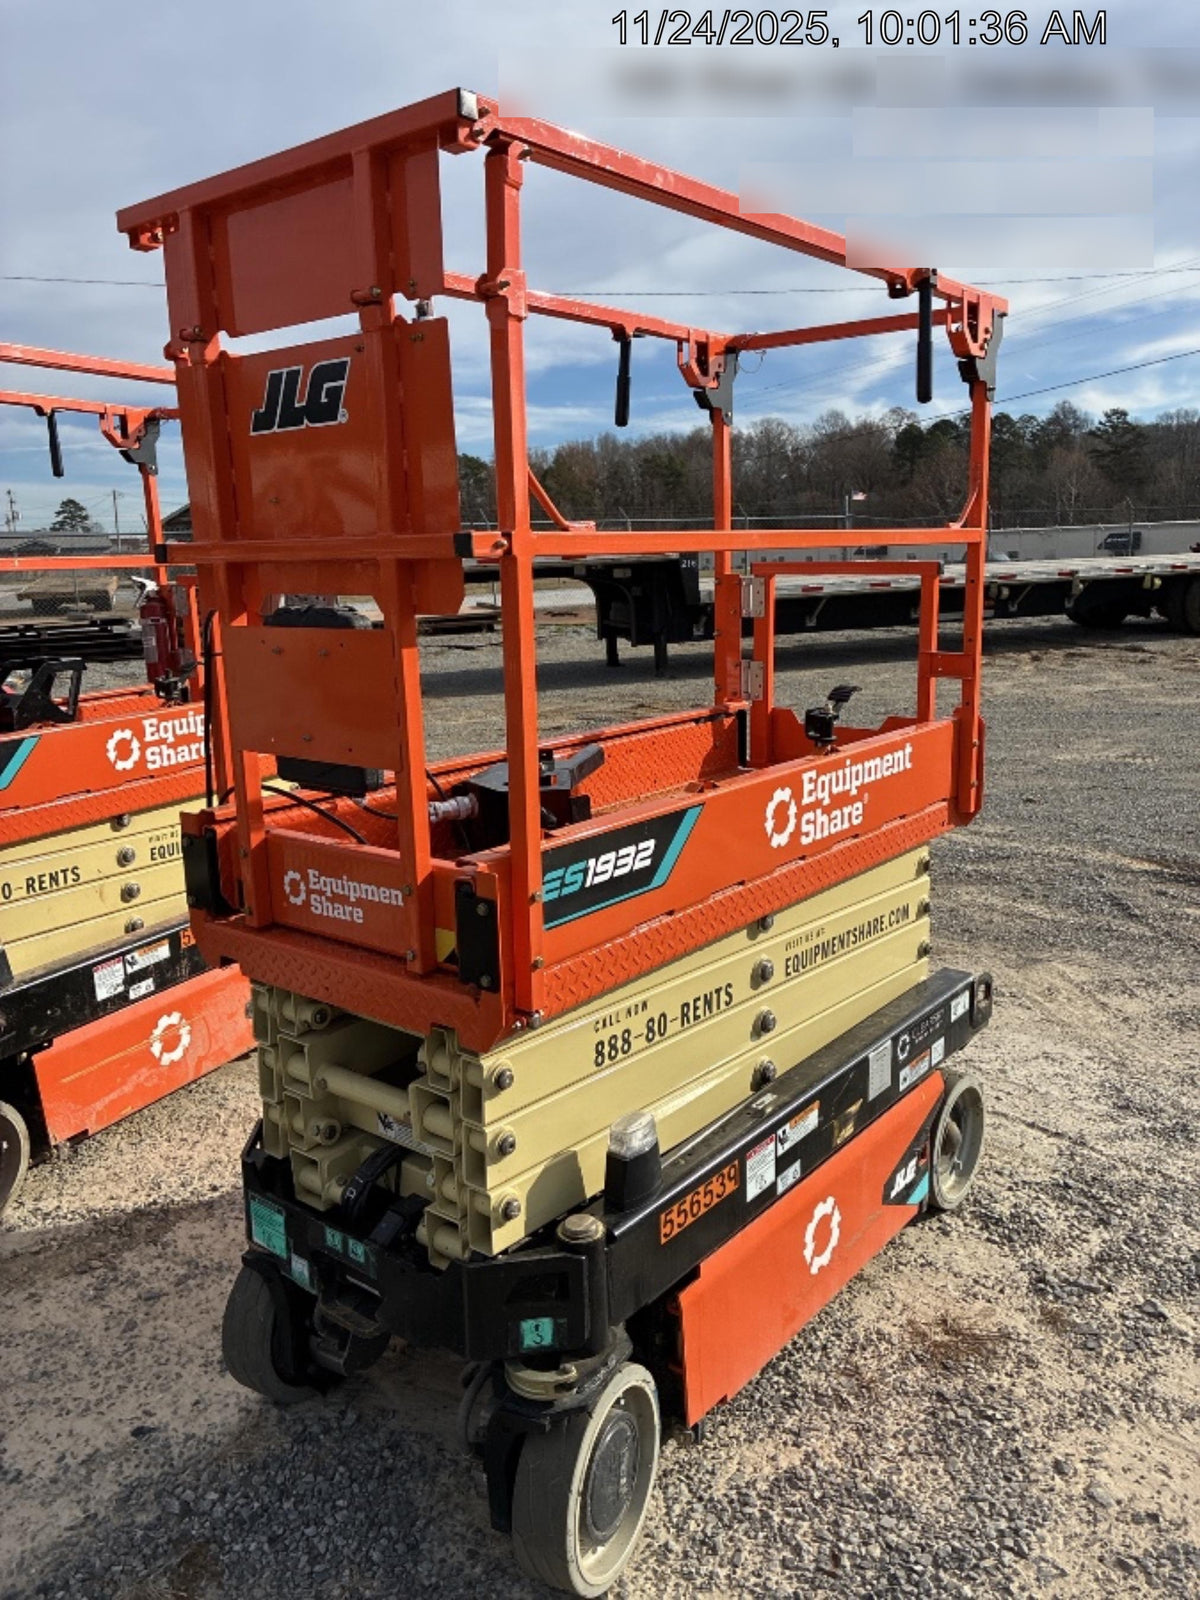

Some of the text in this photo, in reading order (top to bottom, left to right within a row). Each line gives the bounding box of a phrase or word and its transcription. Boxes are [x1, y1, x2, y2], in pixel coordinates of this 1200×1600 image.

[249, 357, 351, 436] JLG
[801, 742, 913, 806] Equipment
[800, 801, 864, 845] Share
[307, 869, 404, 907] Equipmen
[543, 838, 656, 903] ES1932
[310, 894, 364, 924] Share
[785, 903, 910, 977] EQUIPMENTSHARE.COM
[594, 1013, 621, 1034] CALL
[594, 983, 734, 1068] 888-80-RENTS
[662, 1163, 738, 1240] 556539
